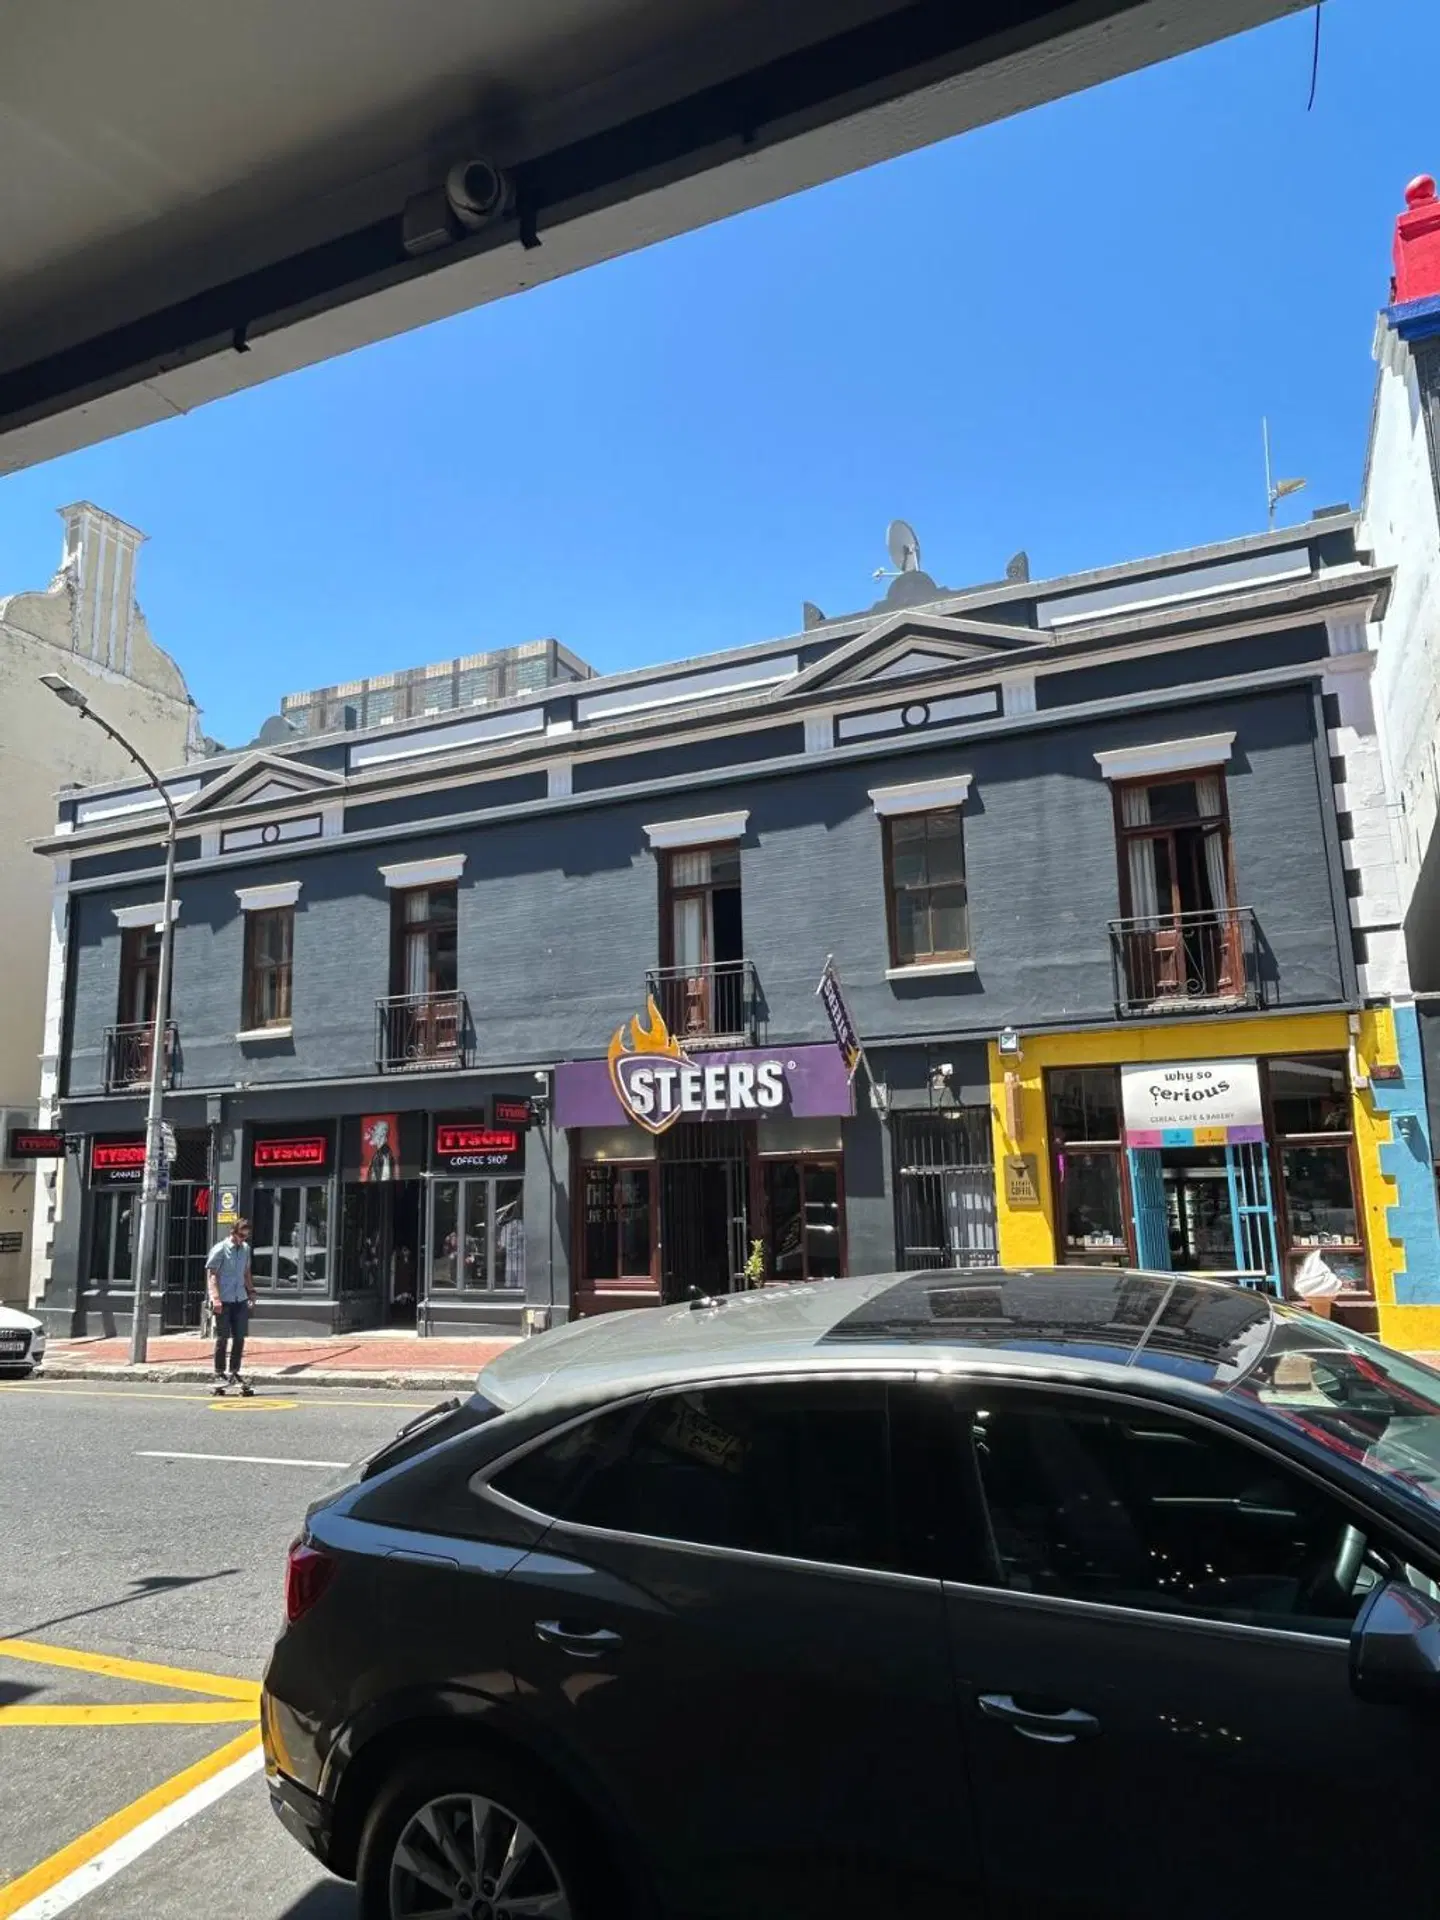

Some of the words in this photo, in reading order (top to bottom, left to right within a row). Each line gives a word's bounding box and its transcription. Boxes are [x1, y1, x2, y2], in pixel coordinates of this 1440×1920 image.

[1164, 1070, 1193, 1082] why
[1197, 1071, 1212, 1080] so
[630, 1060, 784, 1114] STEERS
[443, 1130, 511, 1147] TYSON
[261, 1144, 319, 1159] TYSON
[450, 1155, 485, 1165] COFFEE
[487, 1154, 509, 1164] SHOP
